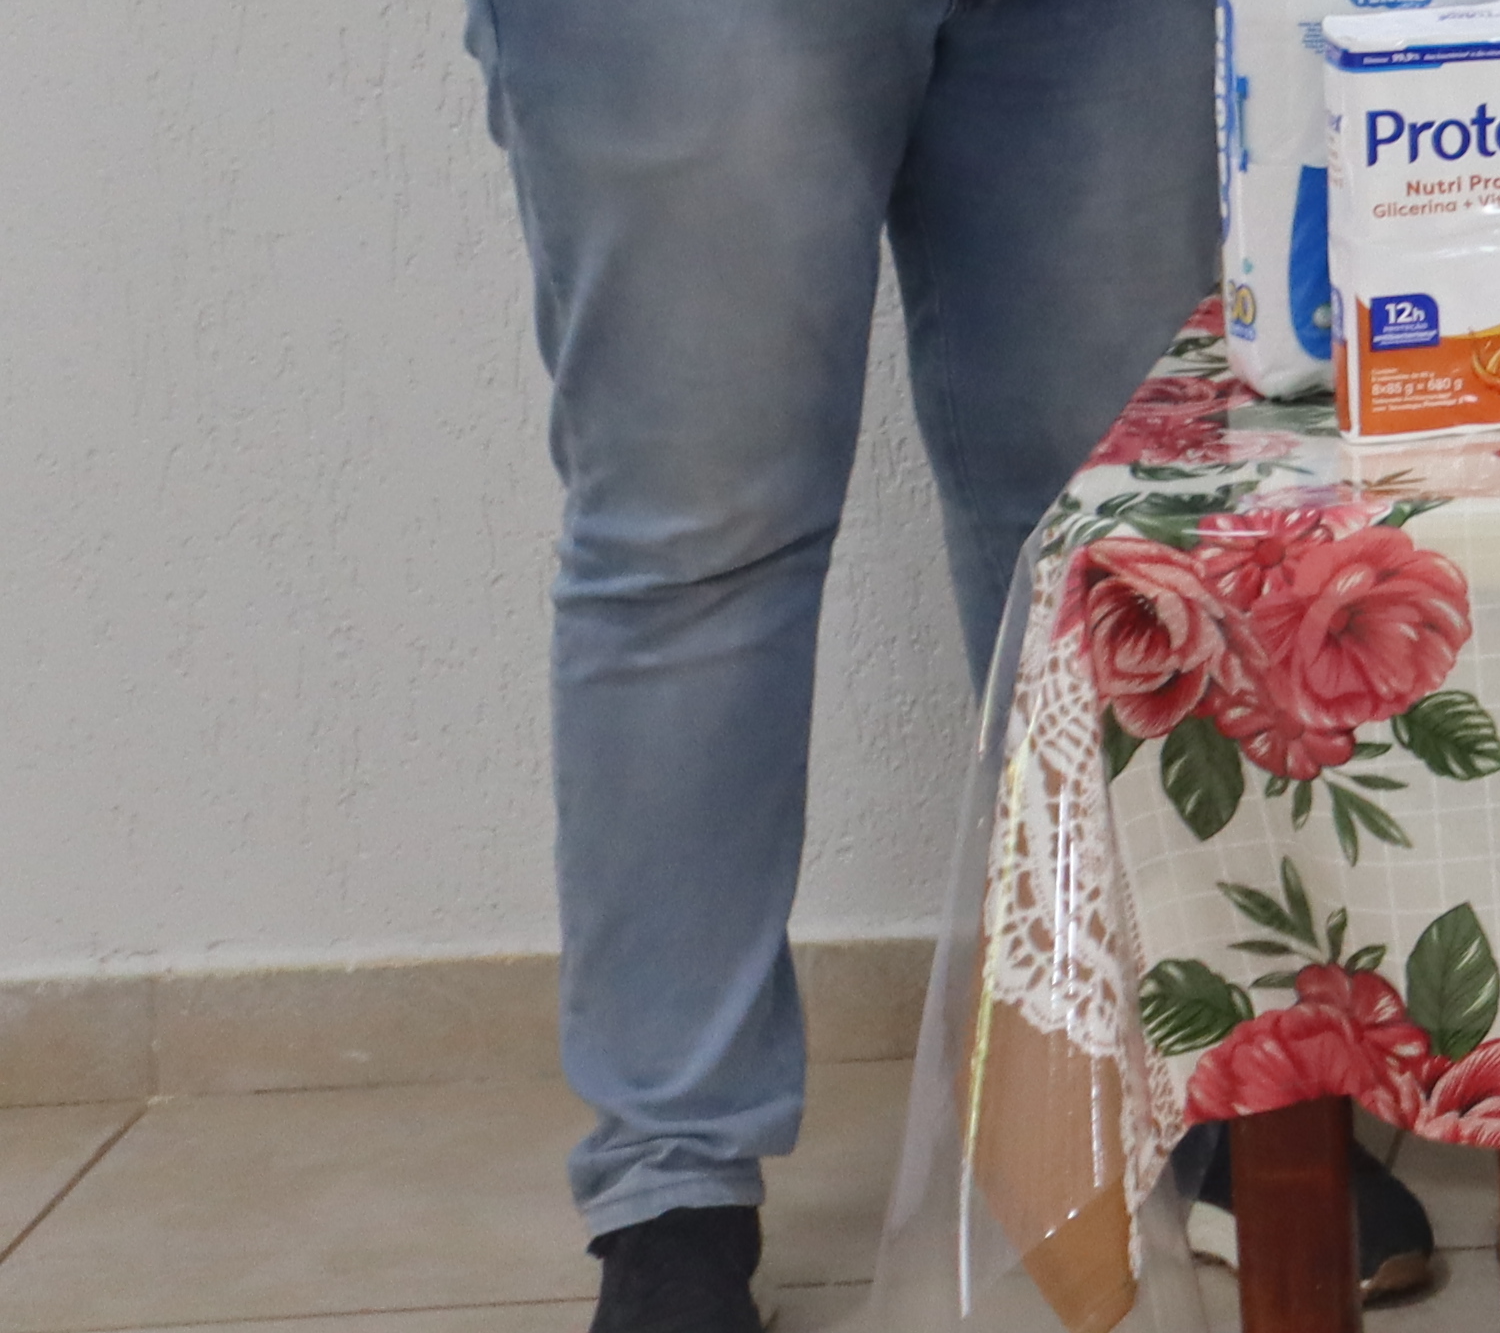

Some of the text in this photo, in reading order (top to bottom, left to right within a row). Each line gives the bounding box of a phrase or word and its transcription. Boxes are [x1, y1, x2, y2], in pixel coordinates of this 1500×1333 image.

[1405, 178, 1463, 198] Nutri
[1372, 199, 1457, 220] Glicerina
[1463, 198, 1474, 209] +
[1384, 301, 1427, 325] 12h
